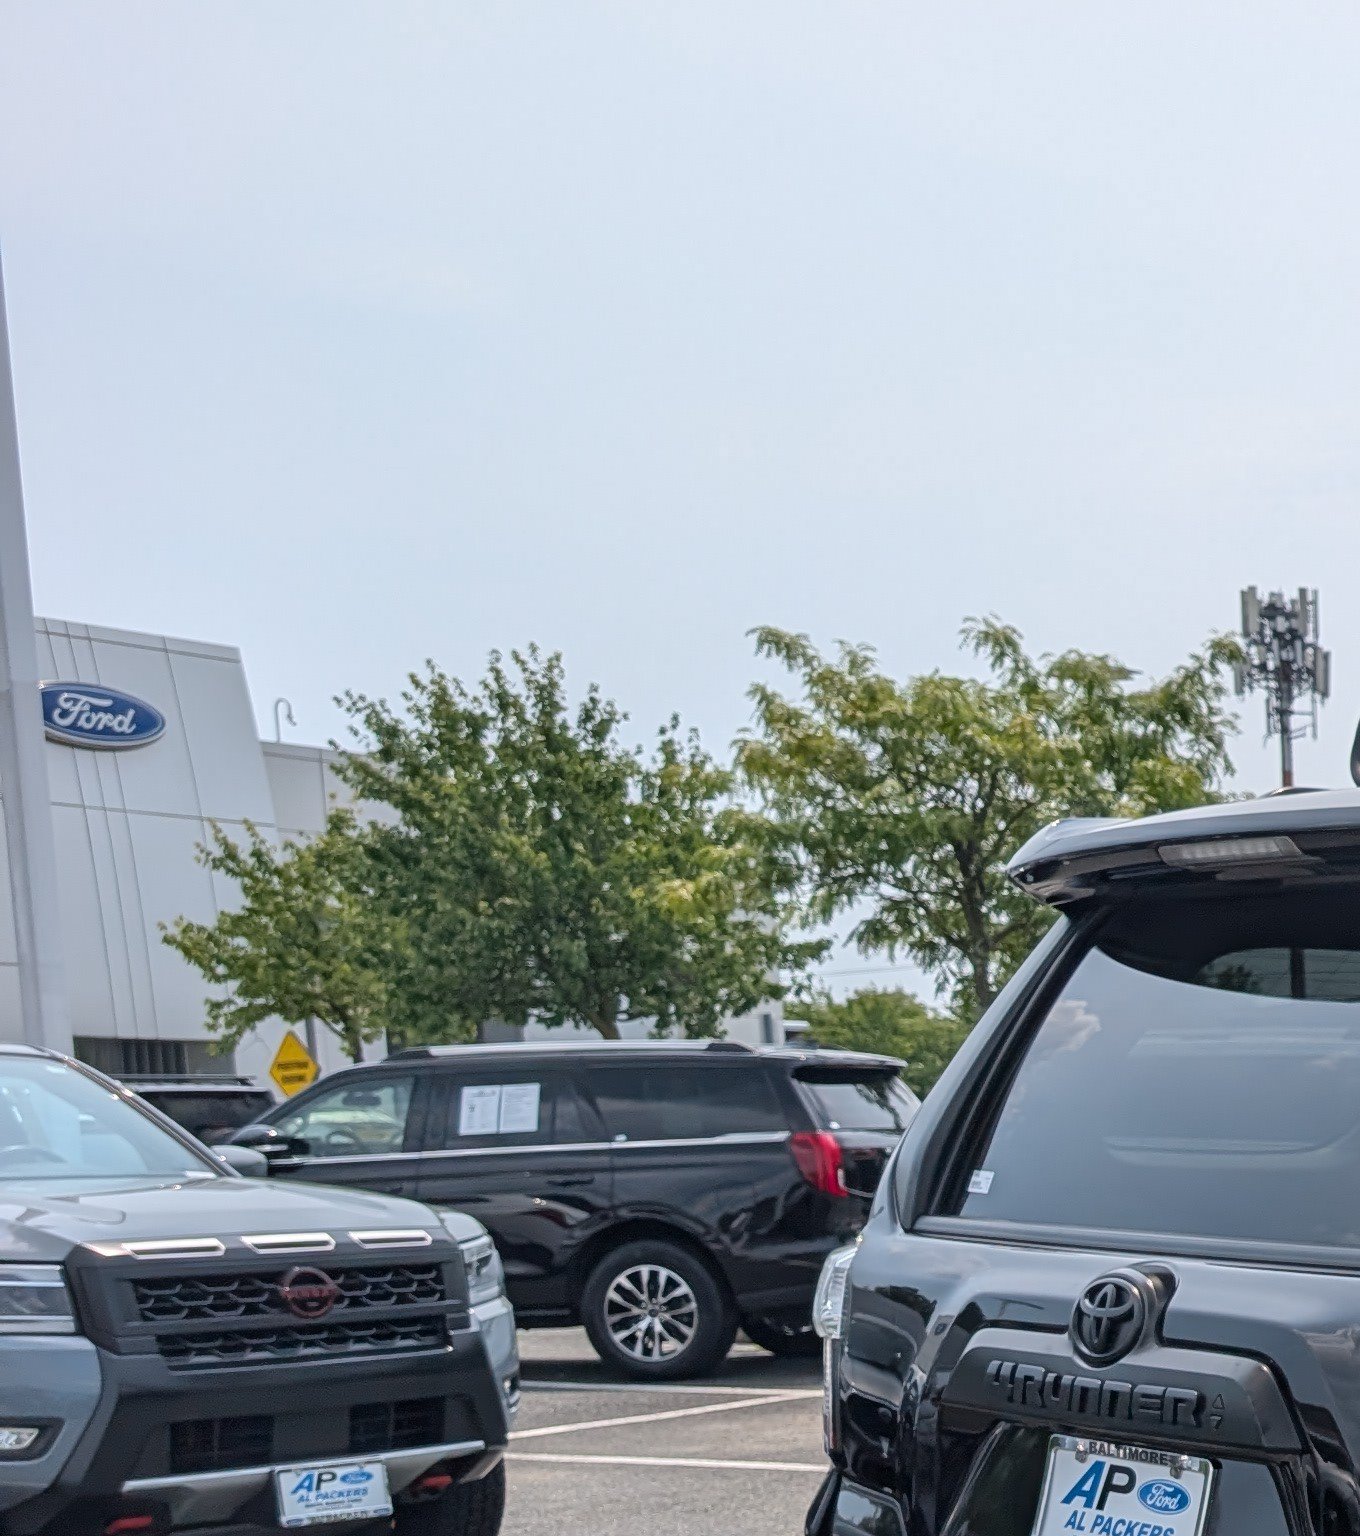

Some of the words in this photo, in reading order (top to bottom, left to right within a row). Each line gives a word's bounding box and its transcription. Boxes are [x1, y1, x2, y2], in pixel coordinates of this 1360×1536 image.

[53, 692, 137, 734] Ford
[986, 1360, 1206, 1427] 4RUNNER
[1088, 1441, 1169, 1466] BALTIMORE
[290, 1471, 337, 1495] AP
[1060, 1460, 1137, 1511] AP
[1147, 1481, 1181, 1510] Ford
[1064, 1509, 1087, 1531] AL
